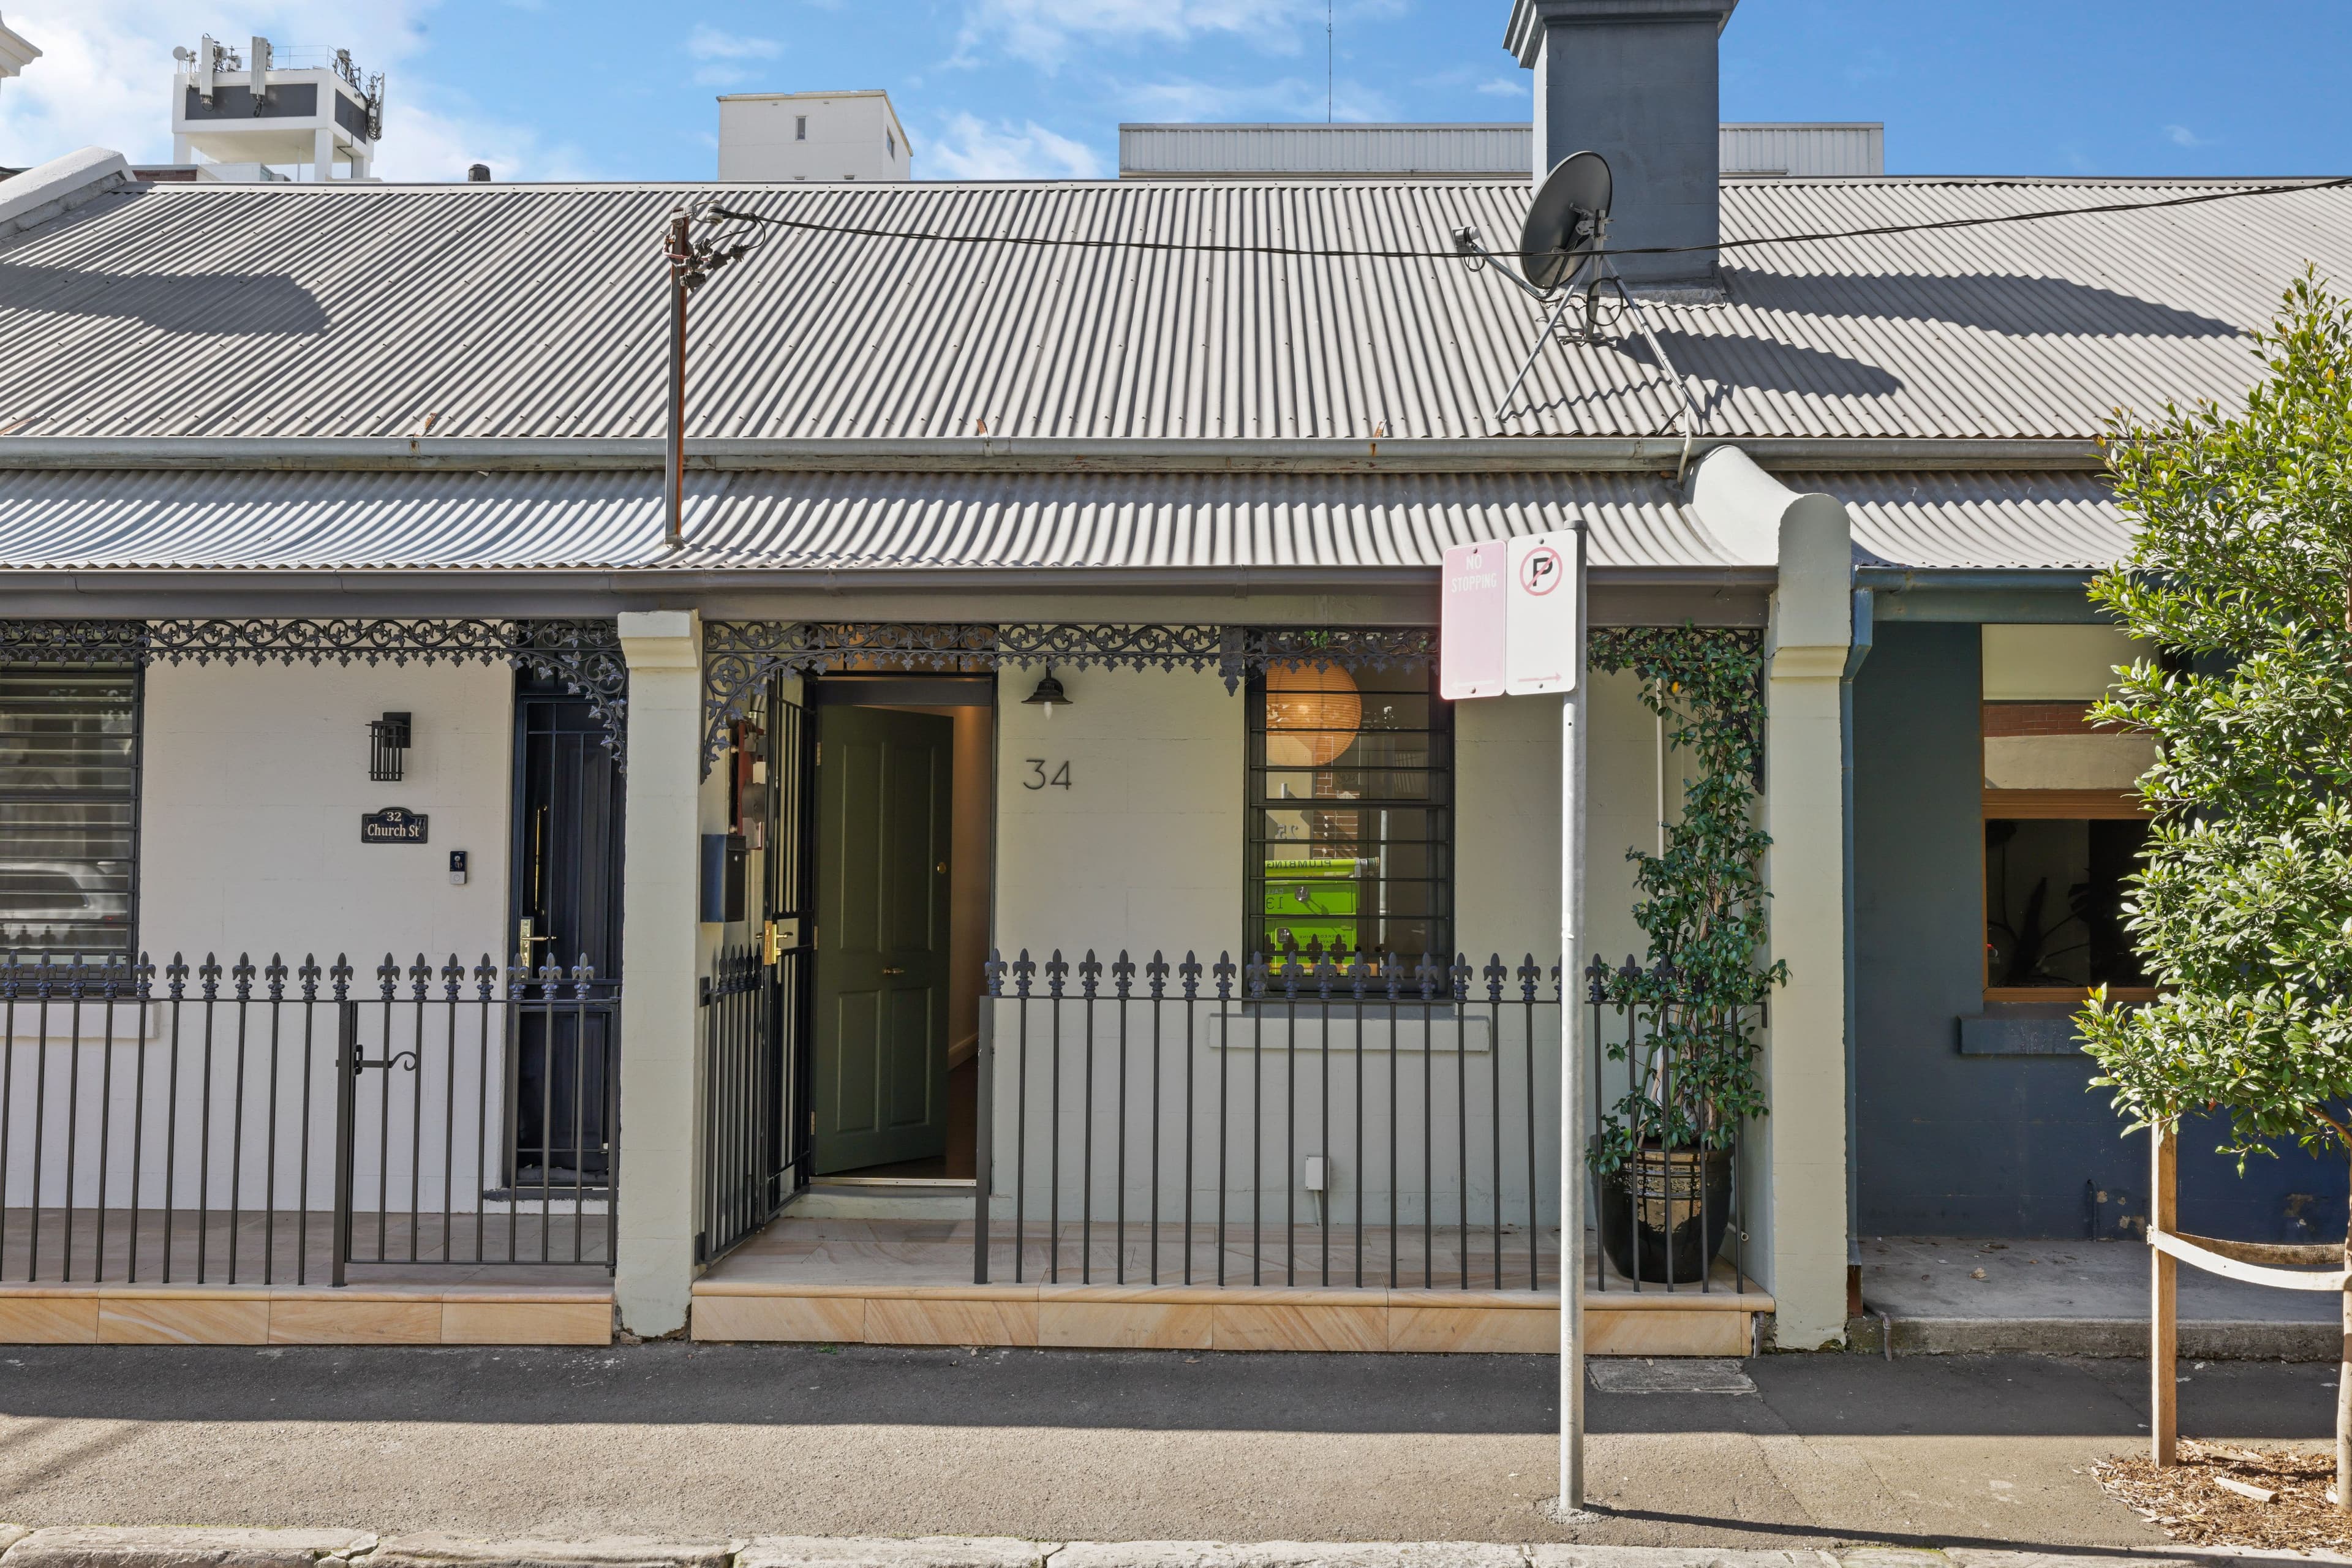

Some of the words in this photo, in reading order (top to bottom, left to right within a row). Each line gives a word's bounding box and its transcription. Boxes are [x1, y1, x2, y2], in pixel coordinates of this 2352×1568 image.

[1466, 554, 1482, 570] NO
[1451, 573, 1498, 593] STOPPING
[1023, 760, 1072, 790] 34
[386, 812, 402, 821] 32
[368, 824, 406, 837] Church
[409, 824, 420, 837] St
